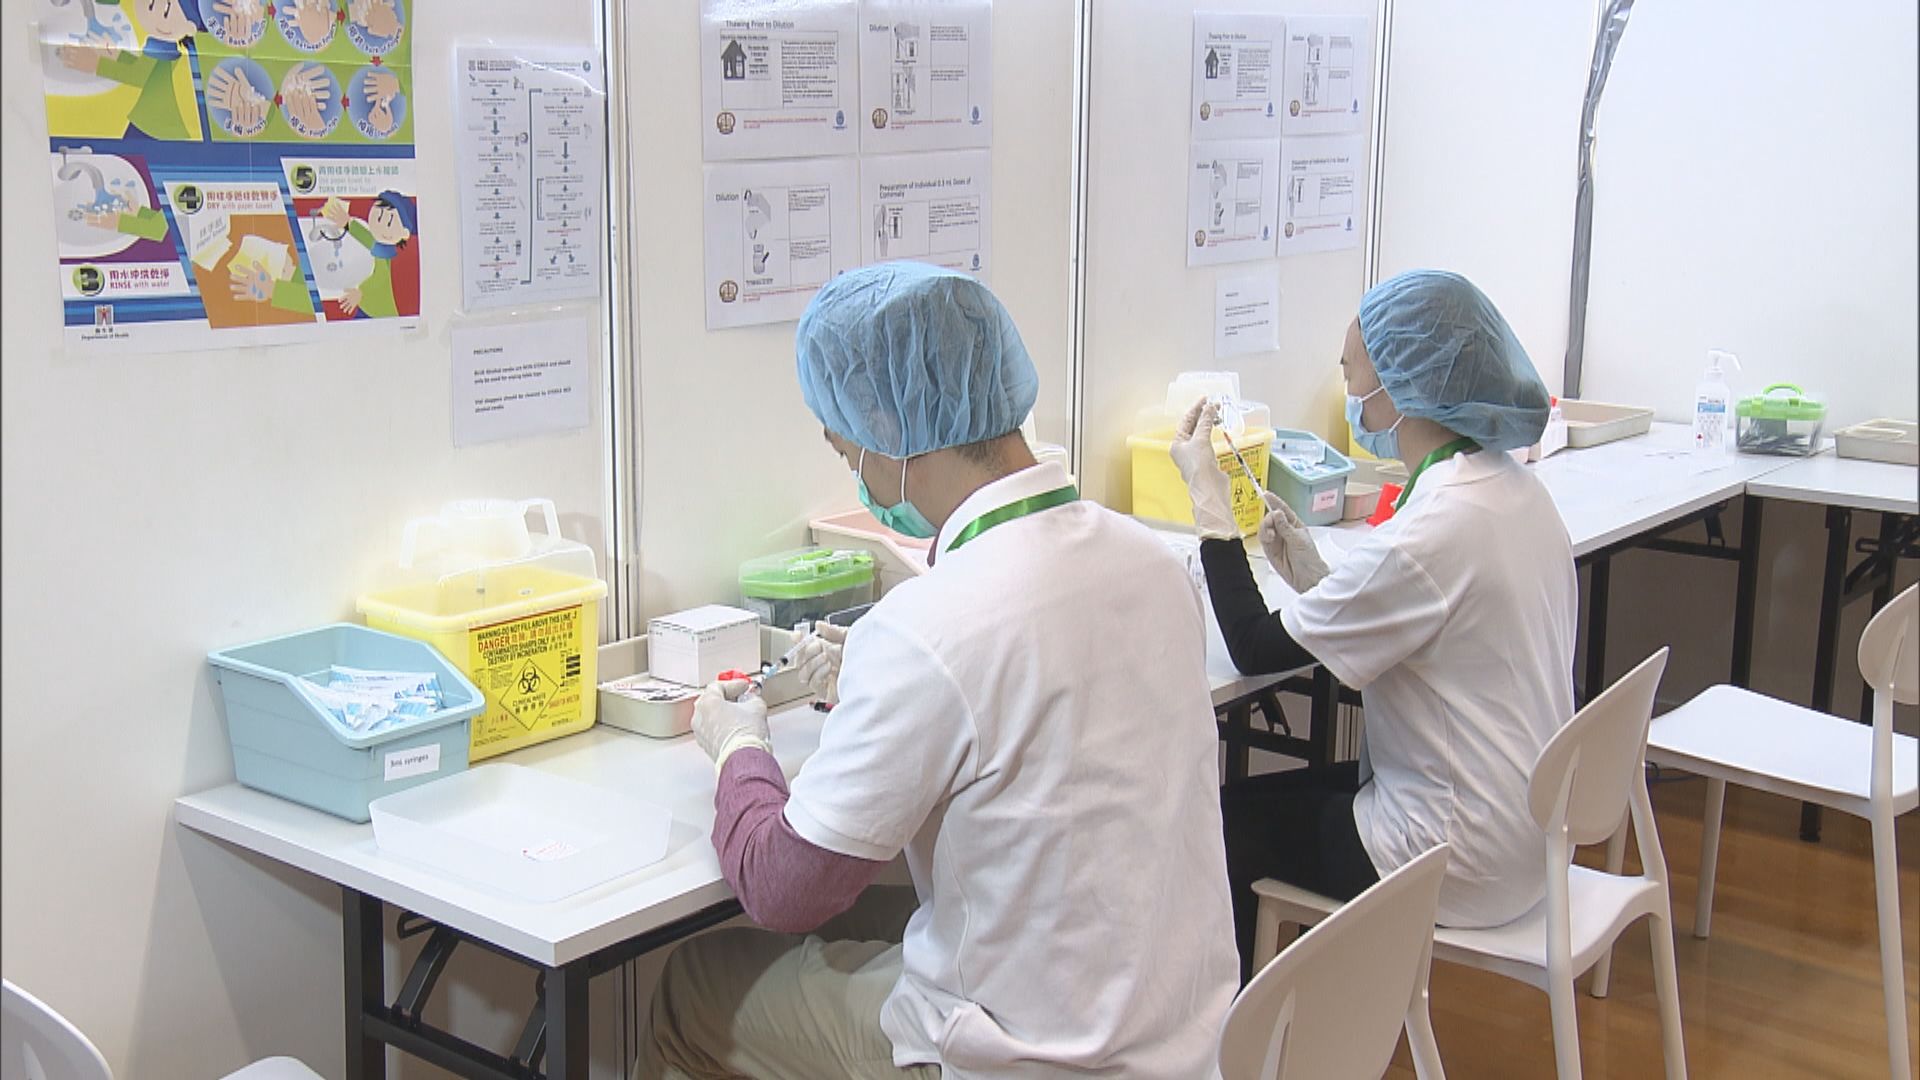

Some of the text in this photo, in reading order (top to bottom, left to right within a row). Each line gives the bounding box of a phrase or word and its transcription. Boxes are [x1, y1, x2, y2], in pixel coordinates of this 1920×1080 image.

[726, 20, 749, 30] Thawing
[751, 20, 764, 28] Prior
[773, 21, 795, 29] Dilution
[296, 167, 313, 189] 5
[179, 186, 200, 208] 4
[716, 194, 739, 202] Dilution
[80, 268, 100, 291] 3
[110, 282, 131, 290] RINSE
[152, 280, 170, 288] water
[473, 347, 503, 355] PRECAUTIONS
[510, 624, 520, 634] NOT
[520, 621, 531, 631] FILL
[532, 618, 548, 628] ABOVE
[549, 615, 559, 624] THIS
[560, 613, 570, 623] LINE
[478, 635, 510, 653] DANGER
[483, 644, 518, 659] CONTAMINATED
[520, 640, 537, 651] SHARPS
[537, 637, 549, 646] ONLY
[488, 653, 509, 666] DESTROY
[510, 652, 517, 660] BY
[517, 646, 548, 659] INCINERATION
[513, 692, 547, 707] CLINICAL WASTE
